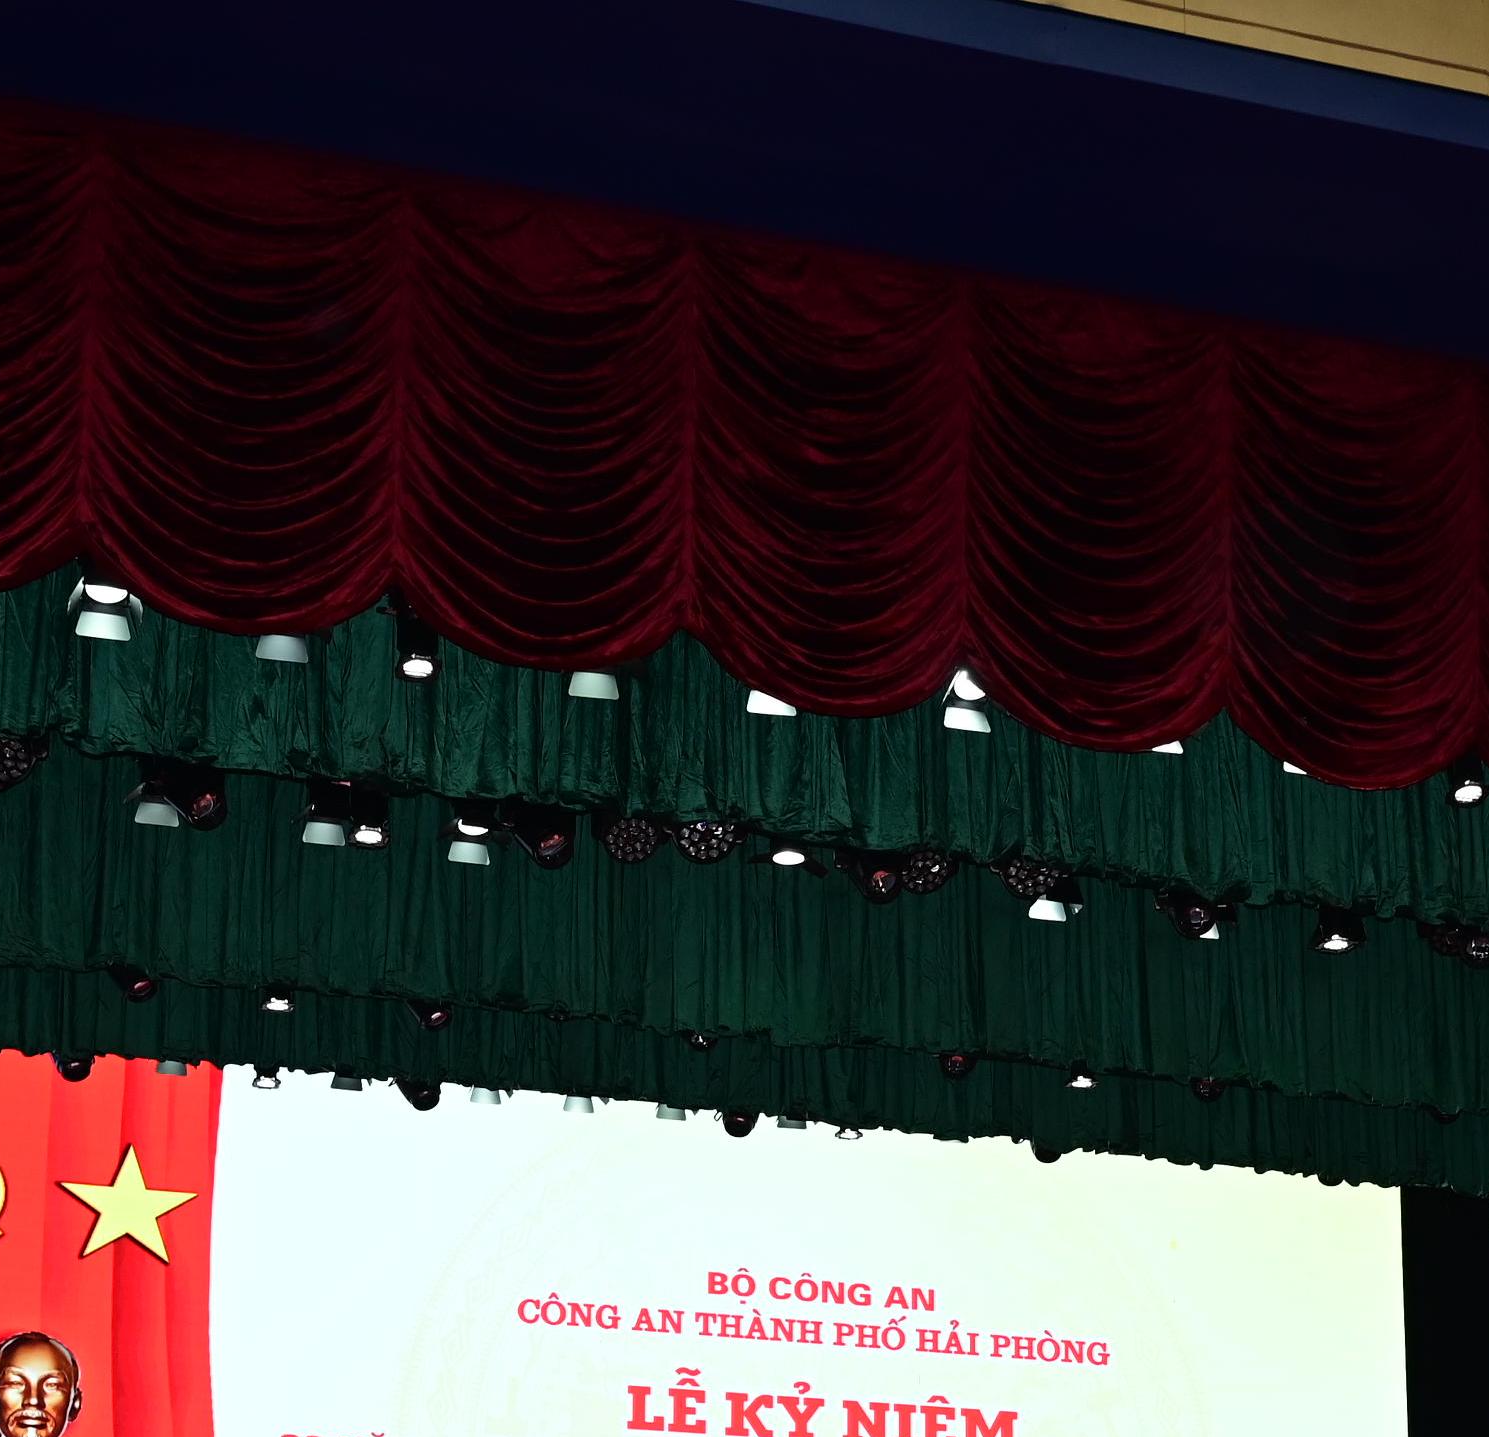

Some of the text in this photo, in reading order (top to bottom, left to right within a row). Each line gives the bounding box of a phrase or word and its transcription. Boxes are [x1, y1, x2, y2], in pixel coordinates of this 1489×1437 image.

[707, 1267, 935, 1312] BỘ CÔNG AN
[517, 1292, 1111, 1366] CÔNG AN THÀNH PHỐ HẢI PHÒNG
[626, 1366, 707, 1435] LỄ
